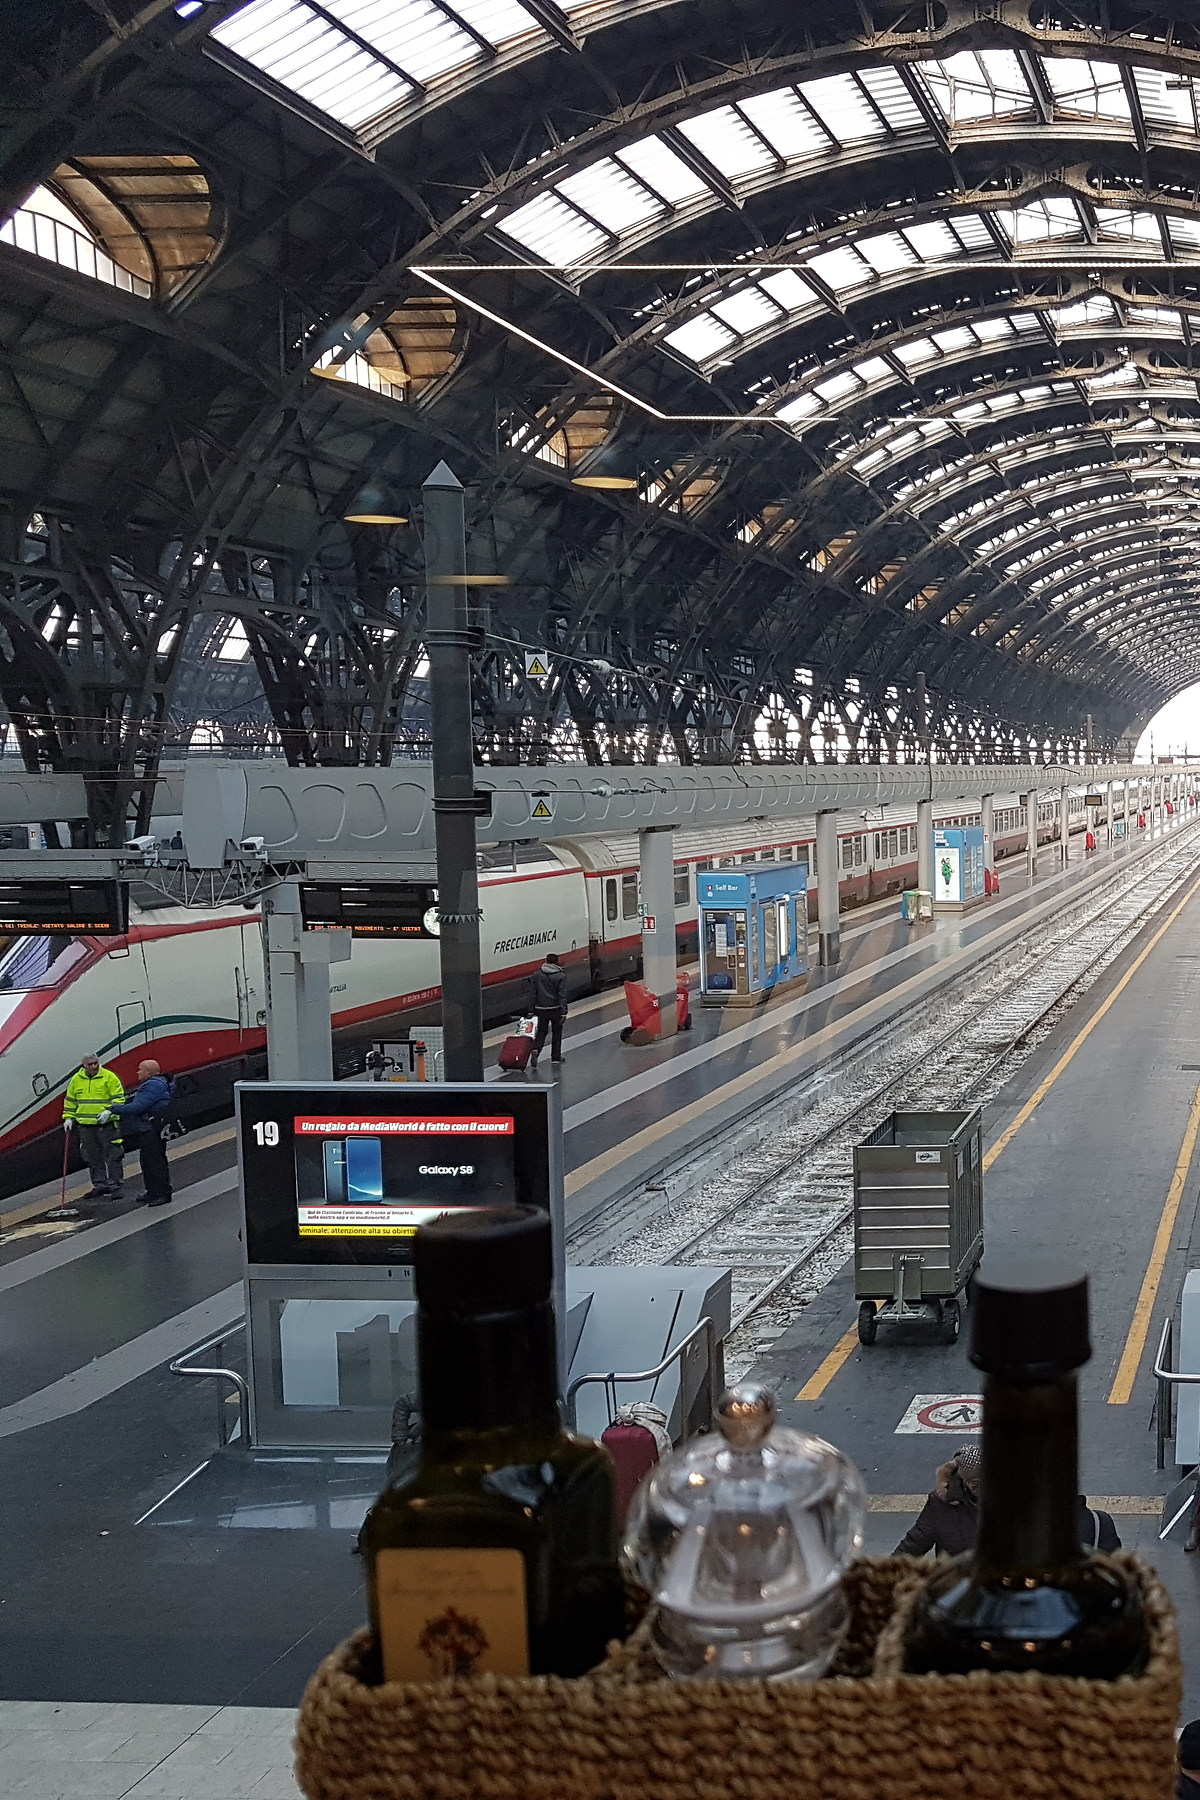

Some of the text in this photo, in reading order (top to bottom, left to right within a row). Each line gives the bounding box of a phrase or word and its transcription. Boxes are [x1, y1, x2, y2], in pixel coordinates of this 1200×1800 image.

[494, 929, 557, 954] FRECCIABIANCA
[302, 1122, 315, 1131] Un
[315, 1122, 347, 1133] regalo
[347, 1122, 360, 1131] da
[360, 1122, 418, 1131] MediaWorld
[425, 1122, 450, 1131] fatto
[451, 1123, 469, 1131] con
[469, 1122, 477, 1131] il
[477, 1122, 509, 1131] cuore!
[252, 1121, 280, 1146] 19
[418, 1165, 474, 1176] Galaxy S8
[331, 1227, 367, 1235] attenzione
[368, 1227, 381, 1235] alta
